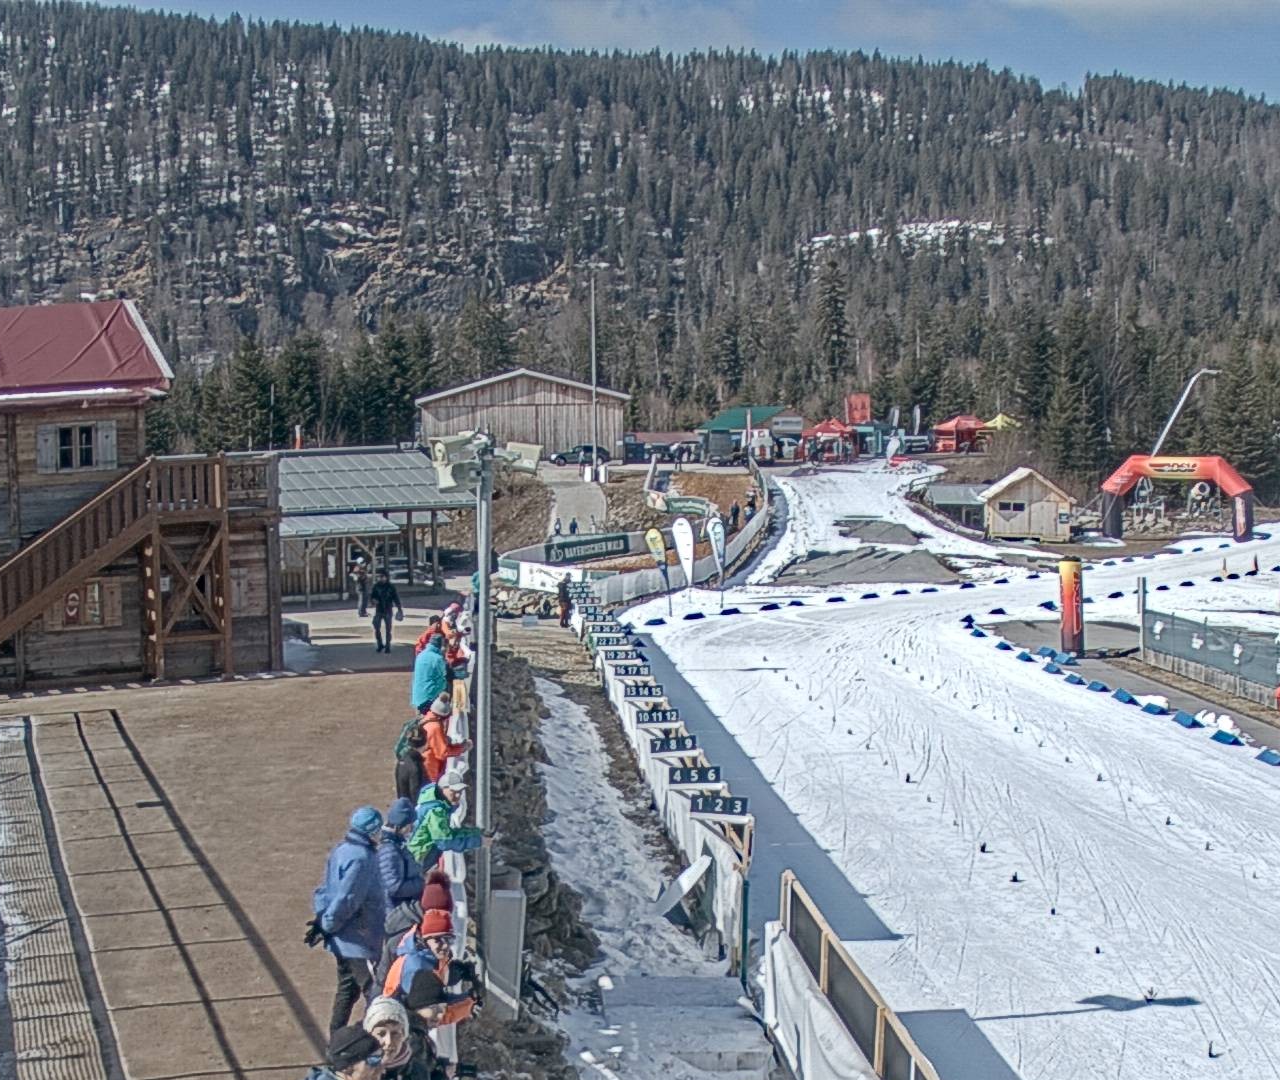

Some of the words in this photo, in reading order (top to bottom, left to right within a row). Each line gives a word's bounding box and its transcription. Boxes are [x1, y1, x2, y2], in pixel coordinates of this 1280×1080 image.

[627, 651, 636, 659] 21
[616, 666, 626, 675] 16
[628, 666, 637, 675] 17
[640, 667, 649, 675] 18
[626, 686, 636, 696] 13
[639, 686, 649, 696] 14
[651, 686, 662, 696] 15
[638, 712, 650, 722] 10
[651, 711, 663, 722] 11
[665, 711, 677, 721] 12
[654, 740, 662, 751] 7
[669, 739, 677, 750] 8
[685, 738, 693, 749] 9
[673, 770, 682, 782] 4
[690, 769, 699, 781] 5
[707, 769, 716, 780] 6
[696, 798, 704, 810] 1
[714, 798, 723, 812] 2
[733, 800, 742, 813] 3
